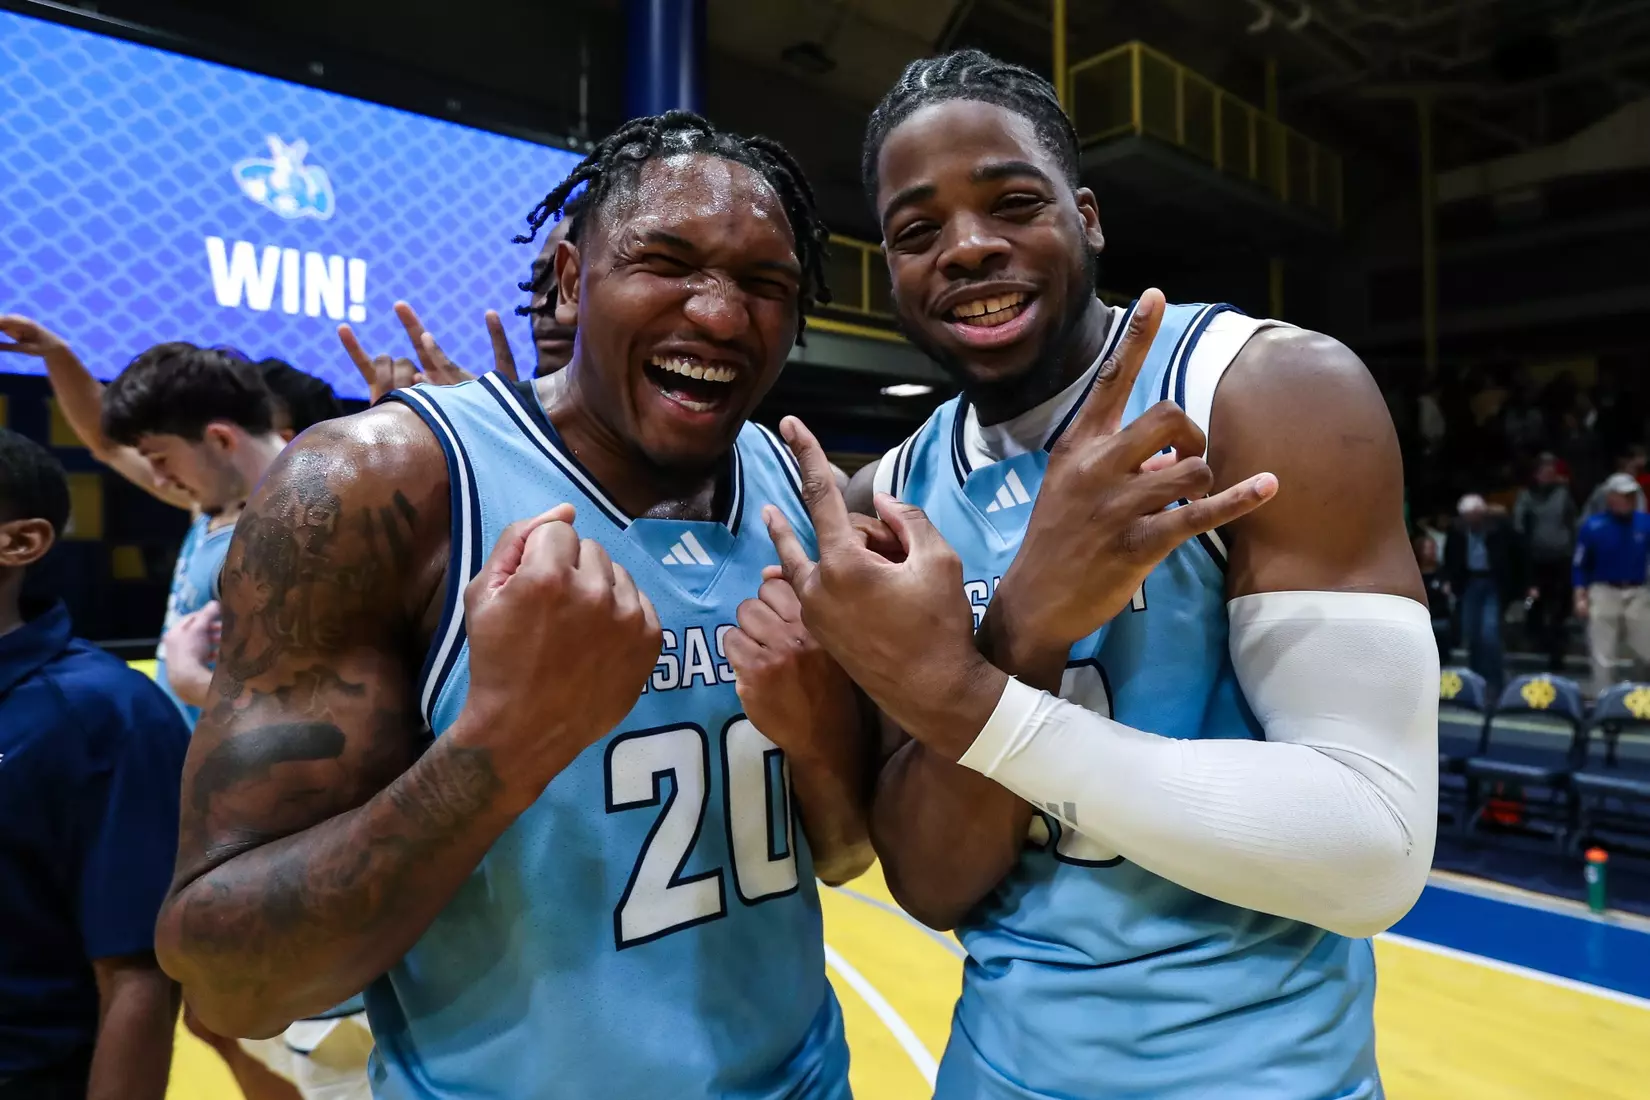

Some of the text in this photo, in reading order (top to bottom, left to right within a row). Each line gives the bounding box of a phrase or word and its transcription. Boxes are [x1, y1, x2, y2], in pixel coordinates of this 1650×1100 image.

[205, 236, 367, 323] WIN!
[641, 624, 737, 695] SAS
[604, 713, 799, 950] 20
